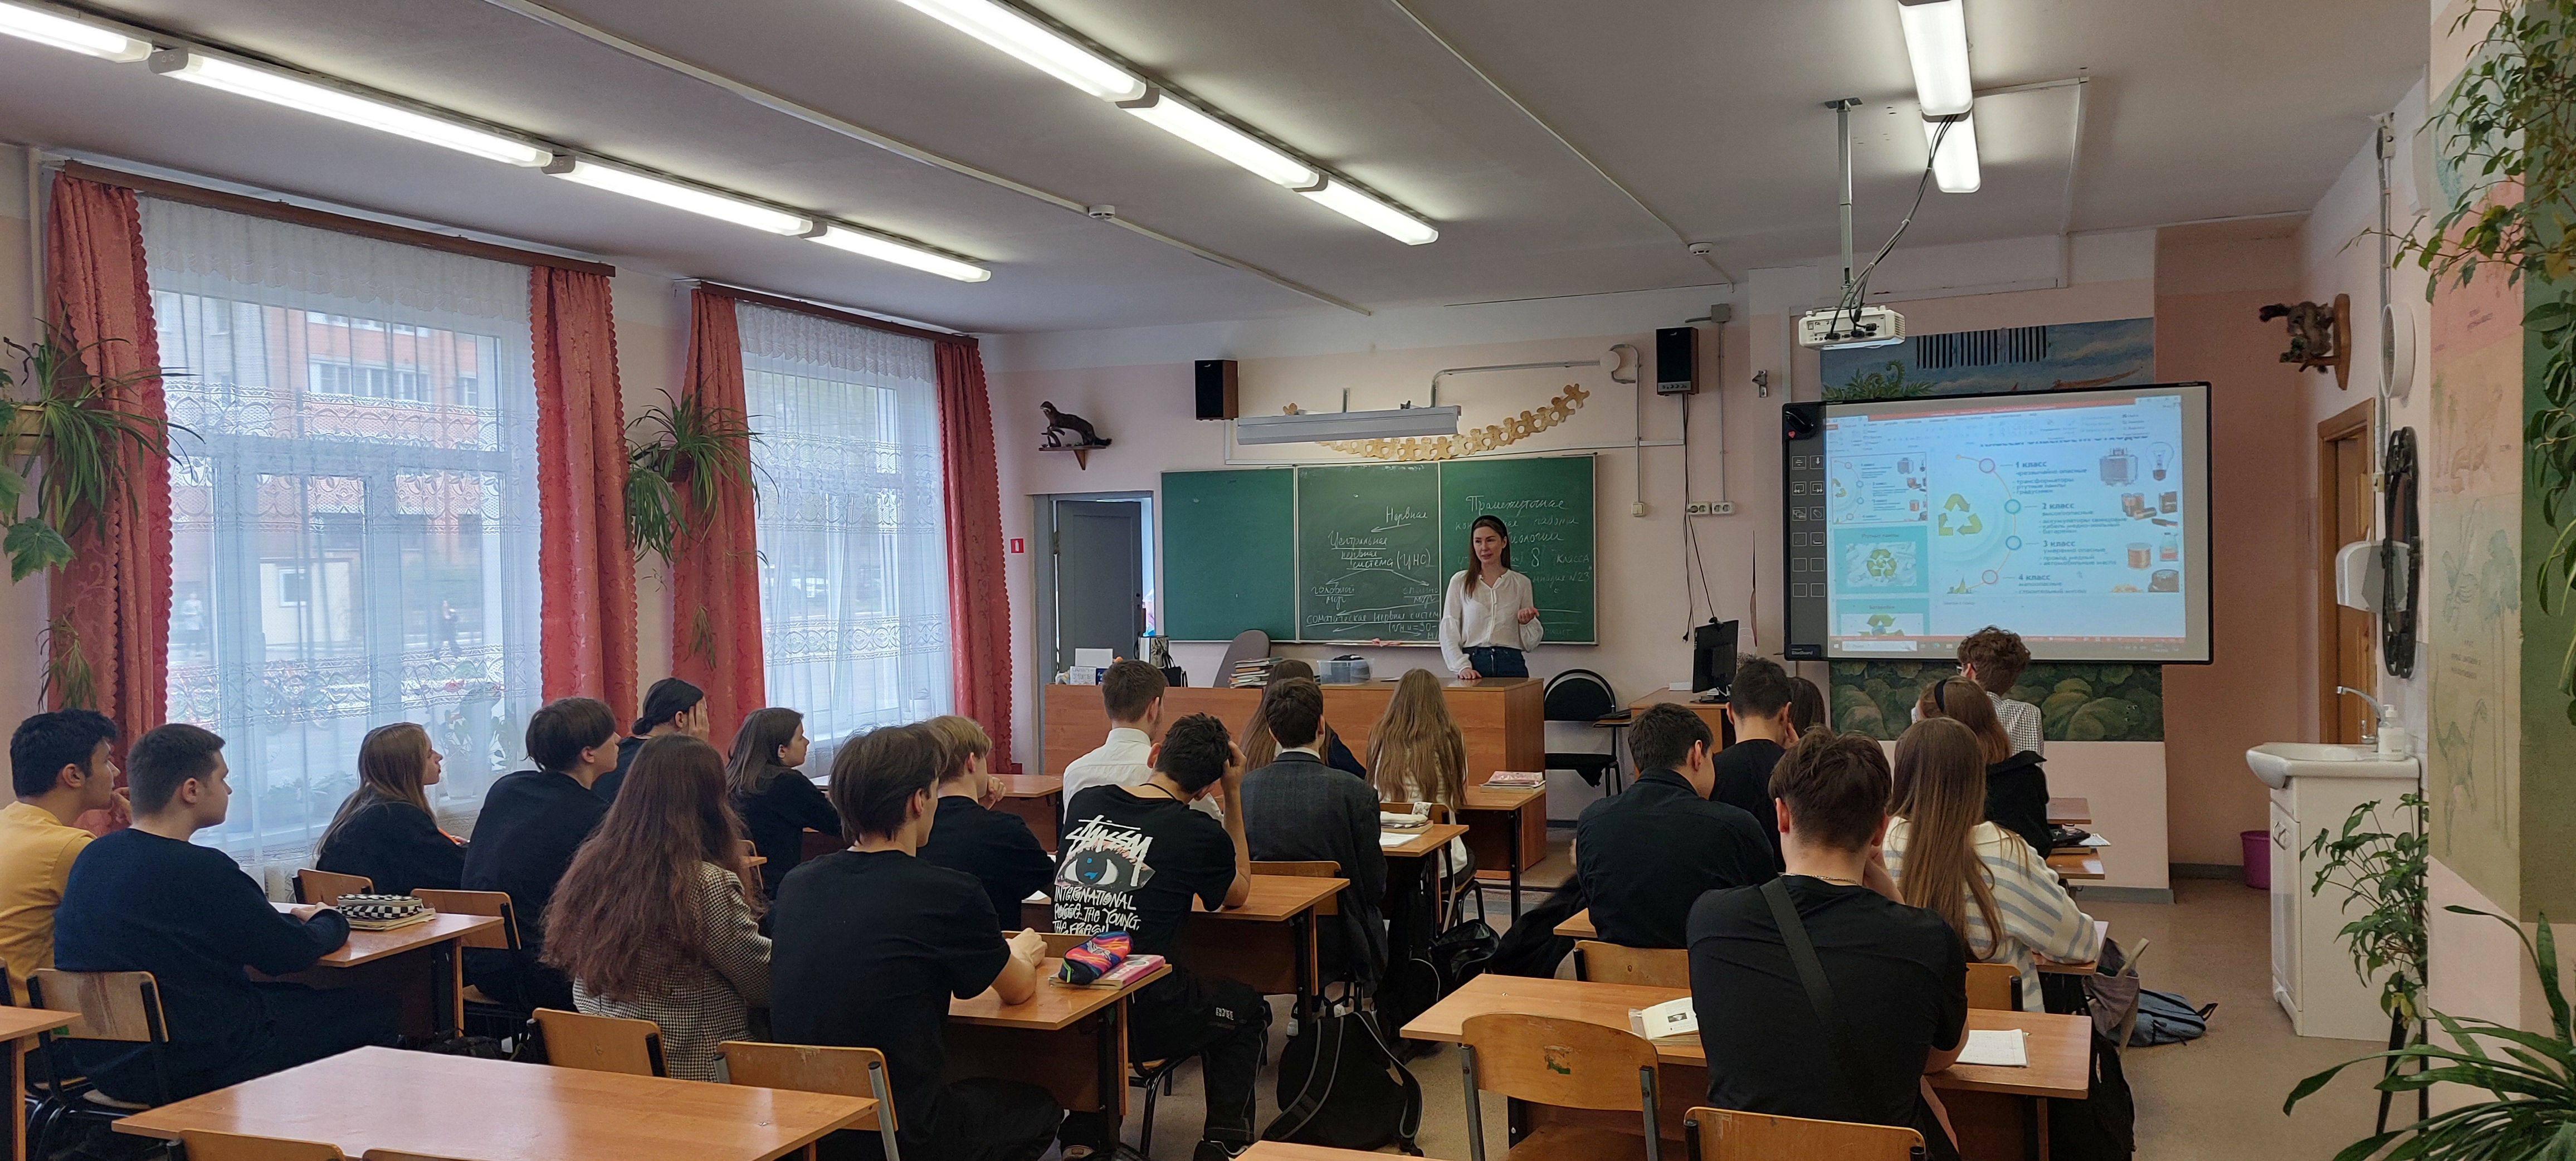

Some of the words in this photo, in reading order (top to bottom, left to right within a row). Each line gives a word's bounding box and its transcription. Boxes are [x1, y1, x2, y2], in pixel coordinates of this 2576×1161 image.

[1397, 548, 1431, 570] (ЦНС)
[1530, 547, 1541, 567] 8
[1409, 612, 1439, 620] систем
[1055, 885, 1136, 910] INTERNATIONAL
